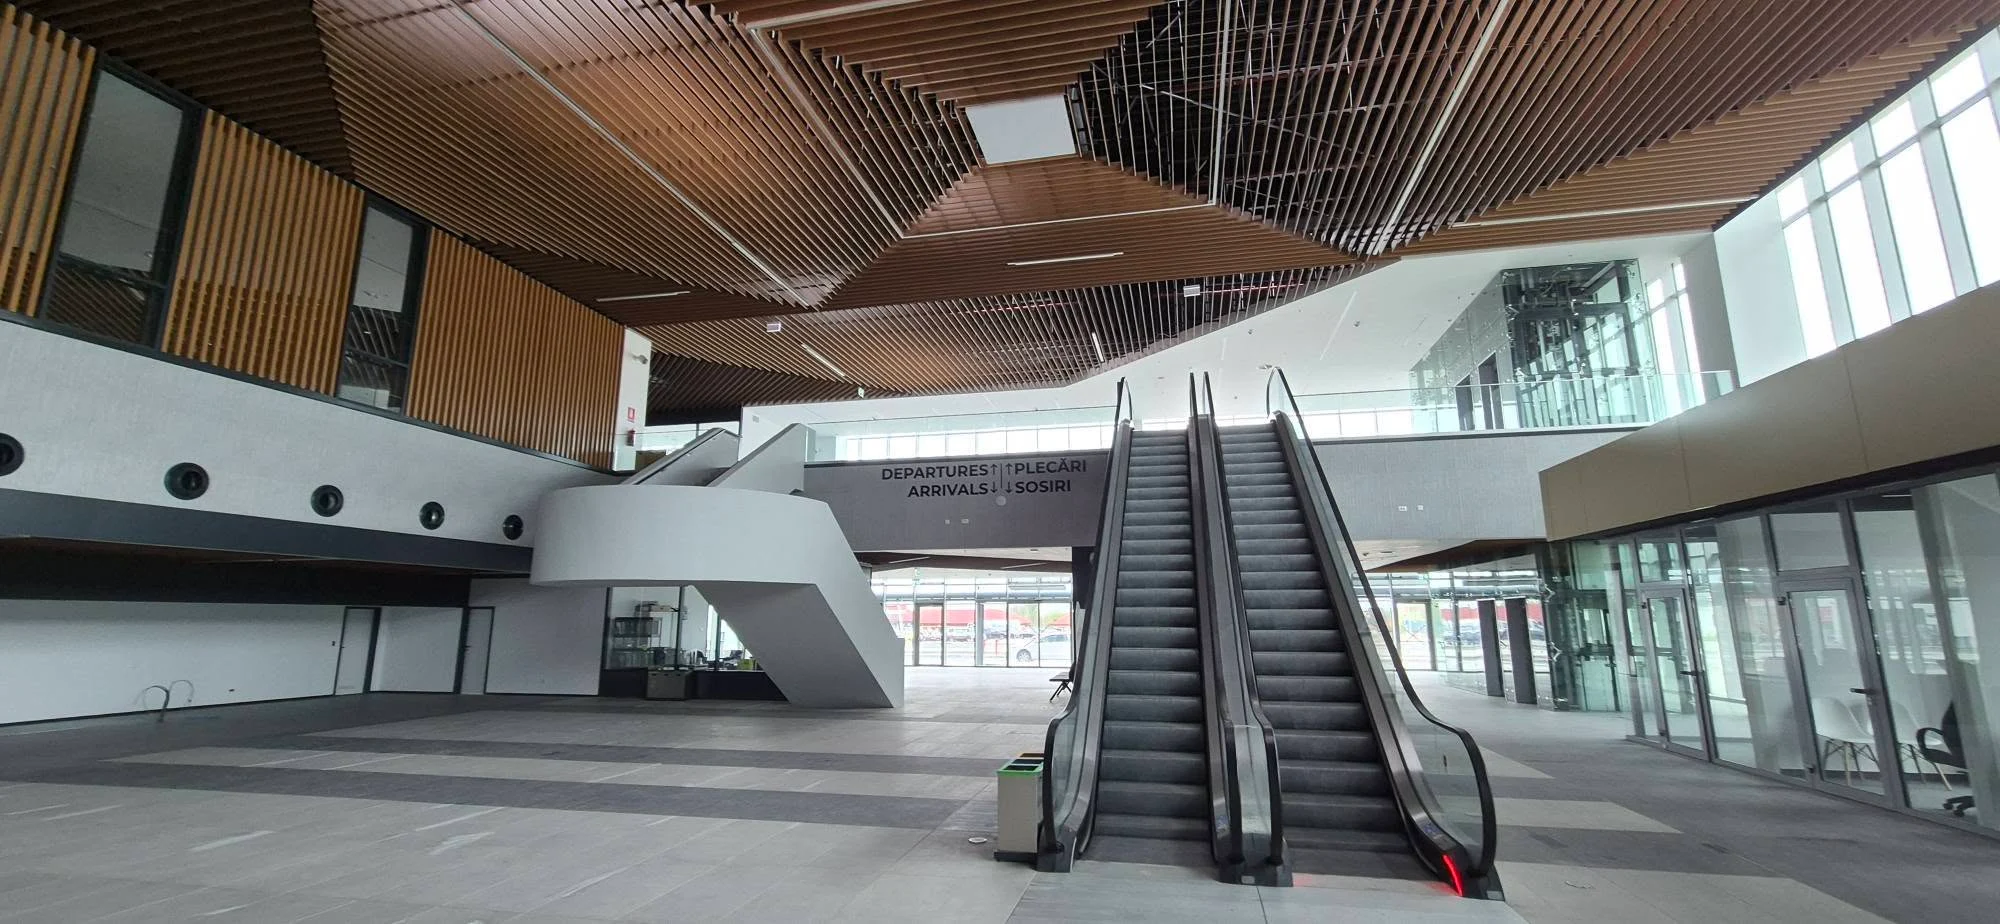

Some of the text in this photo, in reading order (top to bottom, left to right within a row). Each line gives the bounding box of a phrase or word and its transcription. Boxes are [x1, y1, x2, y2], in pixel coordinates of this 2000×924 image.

[881, 464, 989, 480] DEPARTURES
[1014, 458, 1087, 475] PLECĂRI
[907, 482, 989, 498] ARRIVALS
[1015, 479, 1072, 494] SOSIRI
